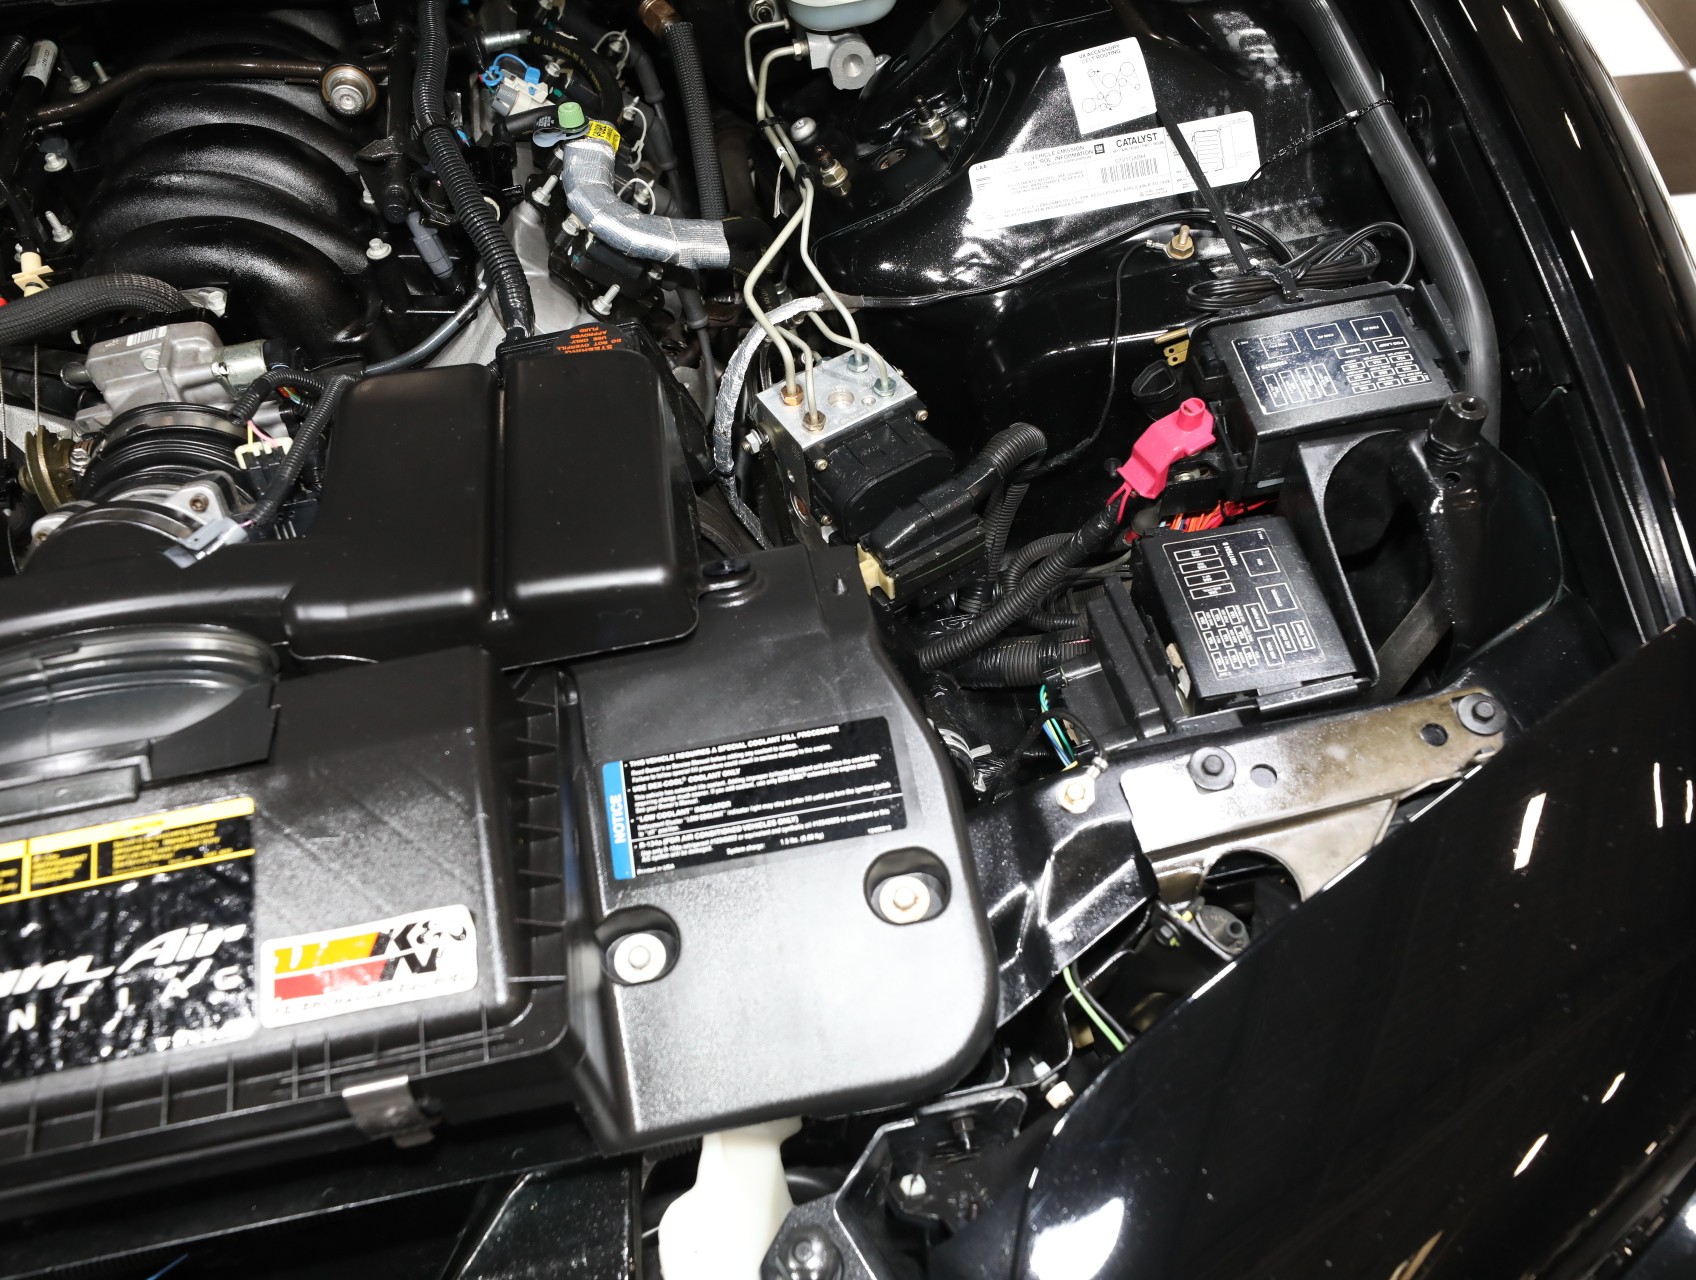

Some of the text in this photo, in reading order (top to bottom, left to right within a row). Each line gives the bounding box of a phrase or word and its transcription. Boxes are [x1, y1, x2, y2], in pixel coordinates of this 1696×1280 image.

[1086, 43, 1120, 56] ACCESSORY
[1115, 132, 1158, 147] CATALYST
[570, 330, 607, 339] APPROVED
[629, 759, 645, 767] THIS
[646, 754, 674, 764] VEHICLE
[676, 748, 710, 759] REQUIRES
[718, 742, 747, 752] SPECIAL
[747, 736, 780, 747] COOLANT
[797, 726, 839, 738] PROCEDURE
[632, 784, 647, 792] USE
[688, 771, 721, 783] COOLANT
[722, 768, 740, 777] ONLY
[609, 793, 627, 844] NOTICE
[694, 801, 731, 813] INDICATOR
[663, 836, 680, 845] (FOR
[681, 834, 694, 842] AIR
[694, 825, 742, 839] CONDITIONED
[742, 819, 777, 831] VEHICLES
[777, 816, 799, 825] ONLY)
[119, 923, 246, 974] Air
